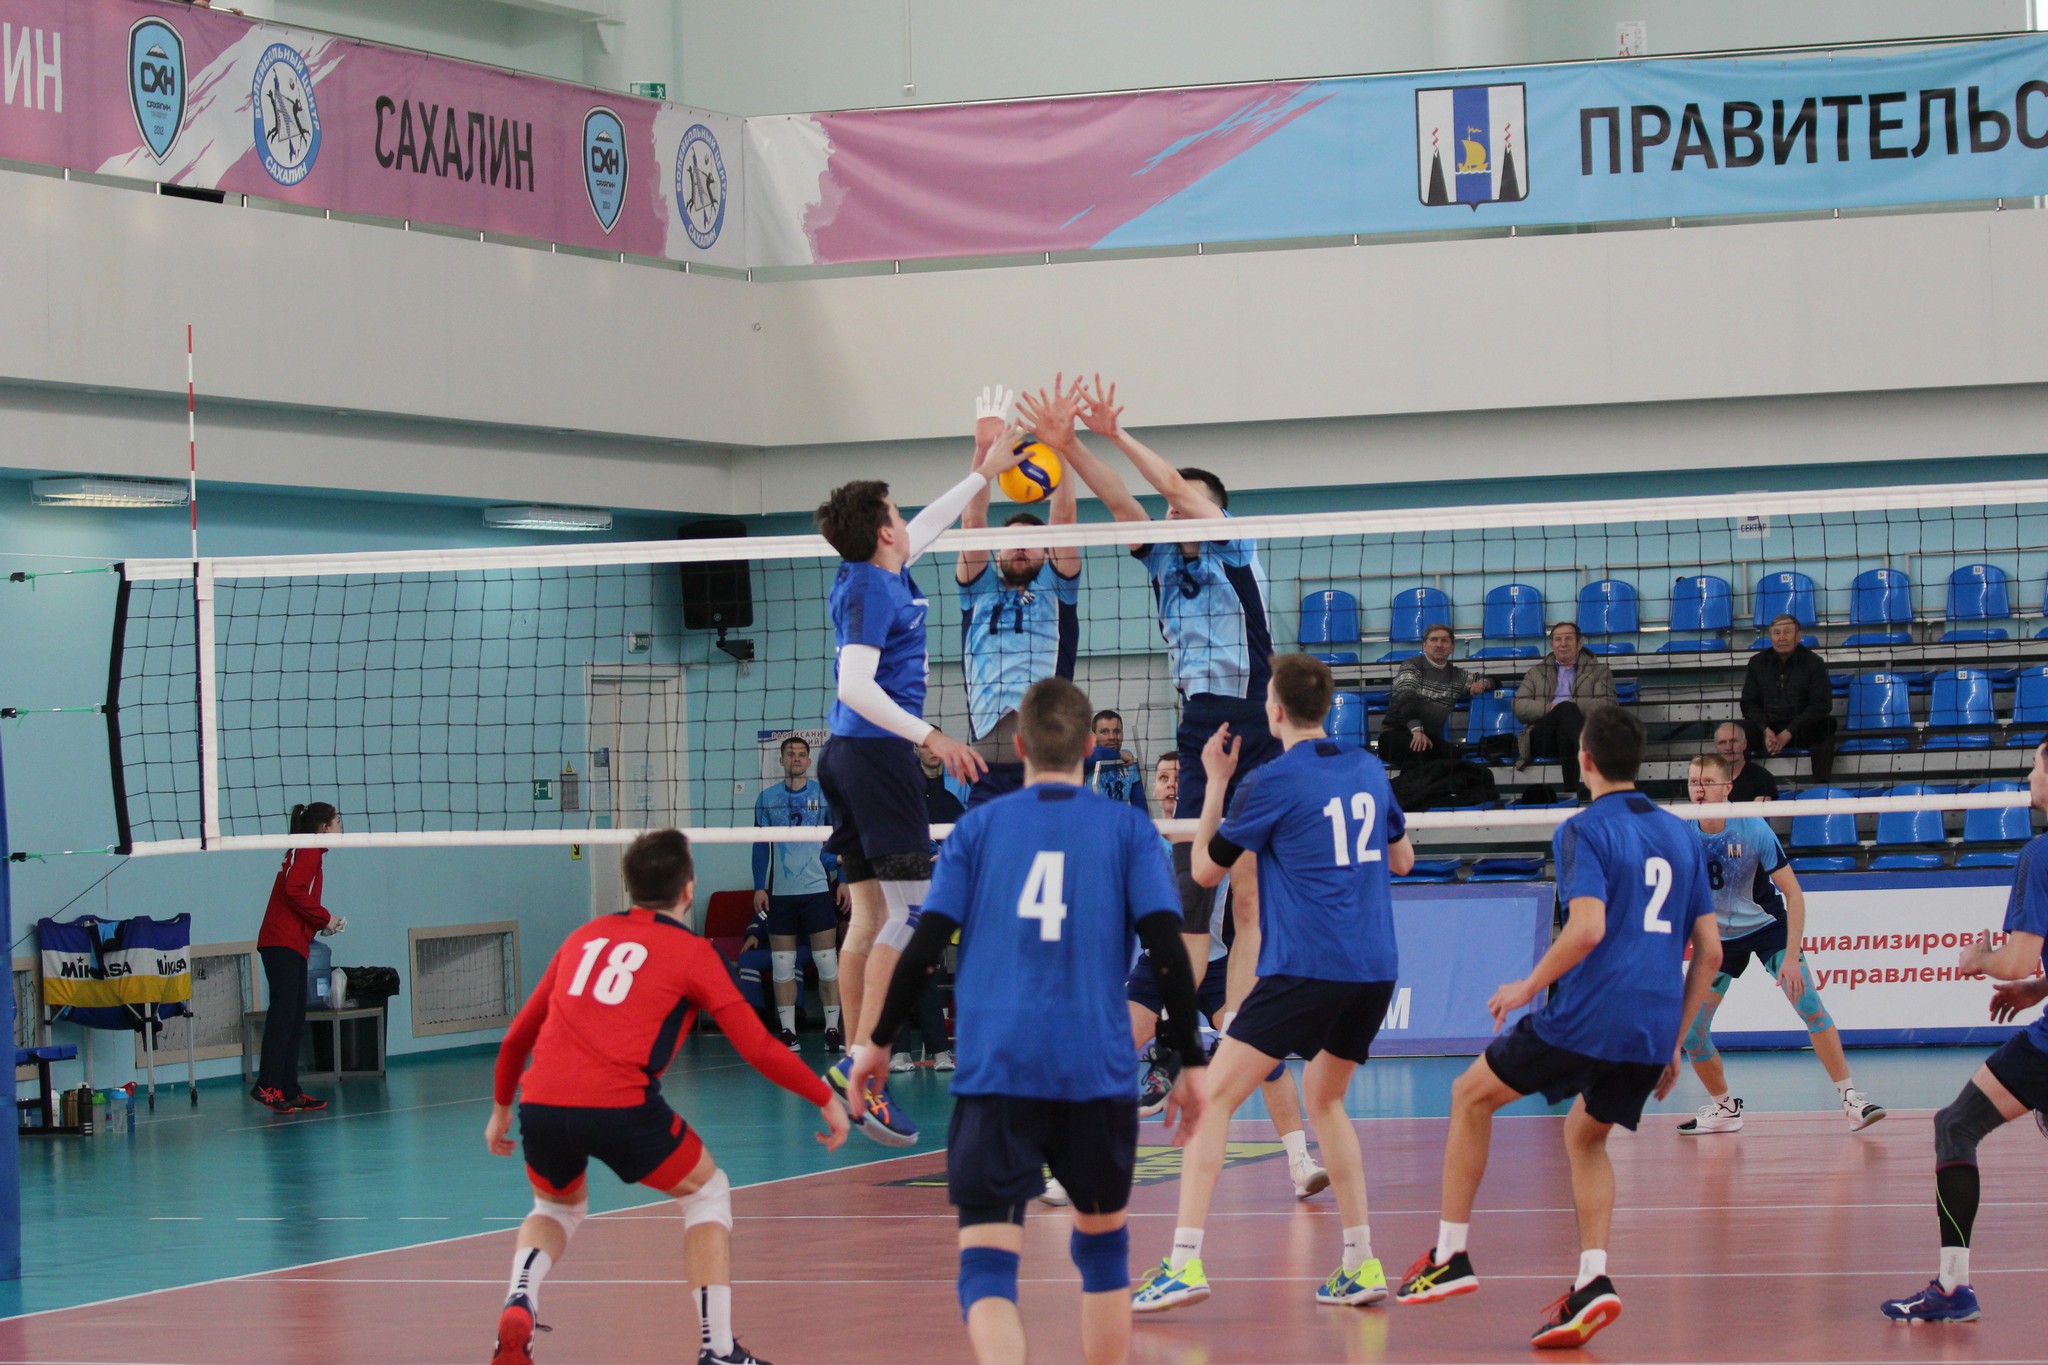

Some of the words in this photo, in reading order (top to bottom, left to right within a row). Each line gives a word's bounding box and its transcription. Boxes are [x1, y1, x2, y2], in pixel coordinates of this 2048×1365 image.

[3, 22, 62, 113] ИН
[254, 47, 304, 119] ВОЛЕЙБОЛЬНЫЙ
[301, 76, 320, 130] ЦЕНТР
[375, 95, 534, 192] САХАЛИН
[1579, 79, 2048, 176] ПРАВИТЕЛЬС
[265, 156, 308, 184] САХАЛИН
[1323, 792, 1382, 866] 12
[1017, 850, 1067, 941] 4
[1643, 856, 1673, 934] 2
[568, 936, 649, 1005] 18
[1815, 965, 1987, 990] управлени
